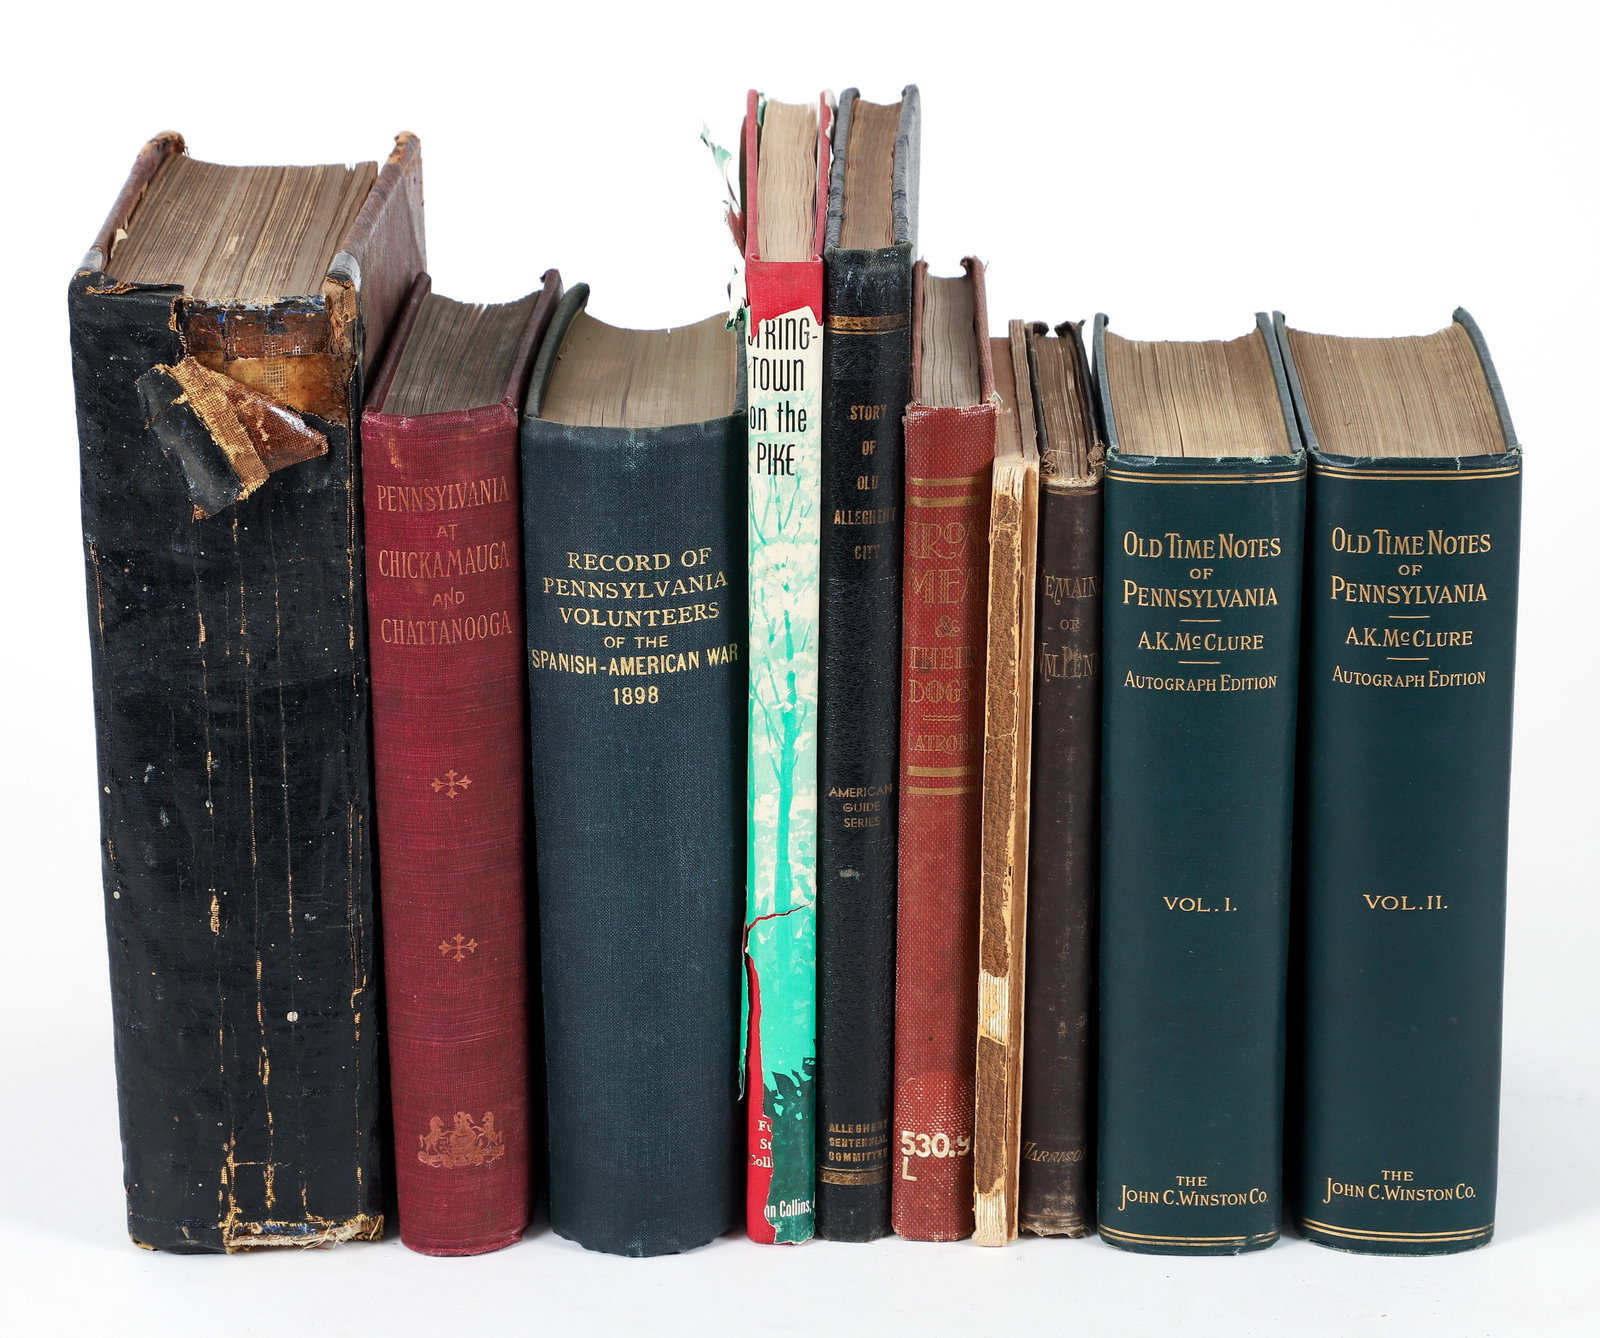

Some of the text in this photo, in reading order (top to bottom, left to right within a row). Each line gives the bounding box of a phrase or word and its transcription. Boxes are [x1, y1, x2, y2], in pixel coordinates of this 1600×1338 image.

[747, 317, 818, 351] TRING-
[752, 356, 804, 392] TOWN
[749, 400, 807, 433] on the
[850, 404, 888, 421] STORY
[756, 442, 796, 476] PIKE
[862, 440, 876, 456] OF
[376, 475, 511, 513] PENNSYLVANIA
[857, 475, 879, 491] OLD
[833, 506, 897, 526] ALLEGHENY
[436, 524, 459, 542] AT
[1123, 531, 1282, 559] OLD TIME NOTES
[1331, 527, 1492, 556] OLD TIME NOTES
[378, 541, 512, 579] CHICKAMAUGA
[567, 547, 713, 573] RECORD OF
[1398, 564, 1423, 576] OF
[543, 570, 729, 600] PENNSYLVANIA
[1189, 568, 1214, 580] OF
[432, 587, 466, 611] AND
[1123, 579, 1280, 608] PENNSYLVANIA
[1330, 574, 1488, 606] PENNSYLVANIA
[559, 602, 720, 628] VOLUNTEERS
[935, 614, 961, 638] &
[380, 610, 513, 647] CHATTANOOGA
[604, 635, 669, 649] OF THE
[532, 643, 739, 677] SPANISH-AMERICAN WAR
[1124, 669, 1278, 692] AUTOGRAPH EDITION
[1332, 665, 1486, 689] AUTOGRAPH EDITION
[612, 686, 659, 706] 1898
[828, 783, 893, 798] AMERICAN
[842, 801, 881, 813] GUIDE
[843, 816, 881, 828] SERIES
[827, 1119, 888, 1134] ALLEGHENY
[828, 1148, 888, 1162] COMMITTEE
[900, 1130, 971, 1159] 530.9
[902, 1156, 918, 1182] L
[1176, 1175, 1208, 1187] THE
[1382, 1170, 1414, 1182] THE
[1117, 1185, 1159, 1211] JOHN
[1323, 1177, 1365, 1203] JOHN
